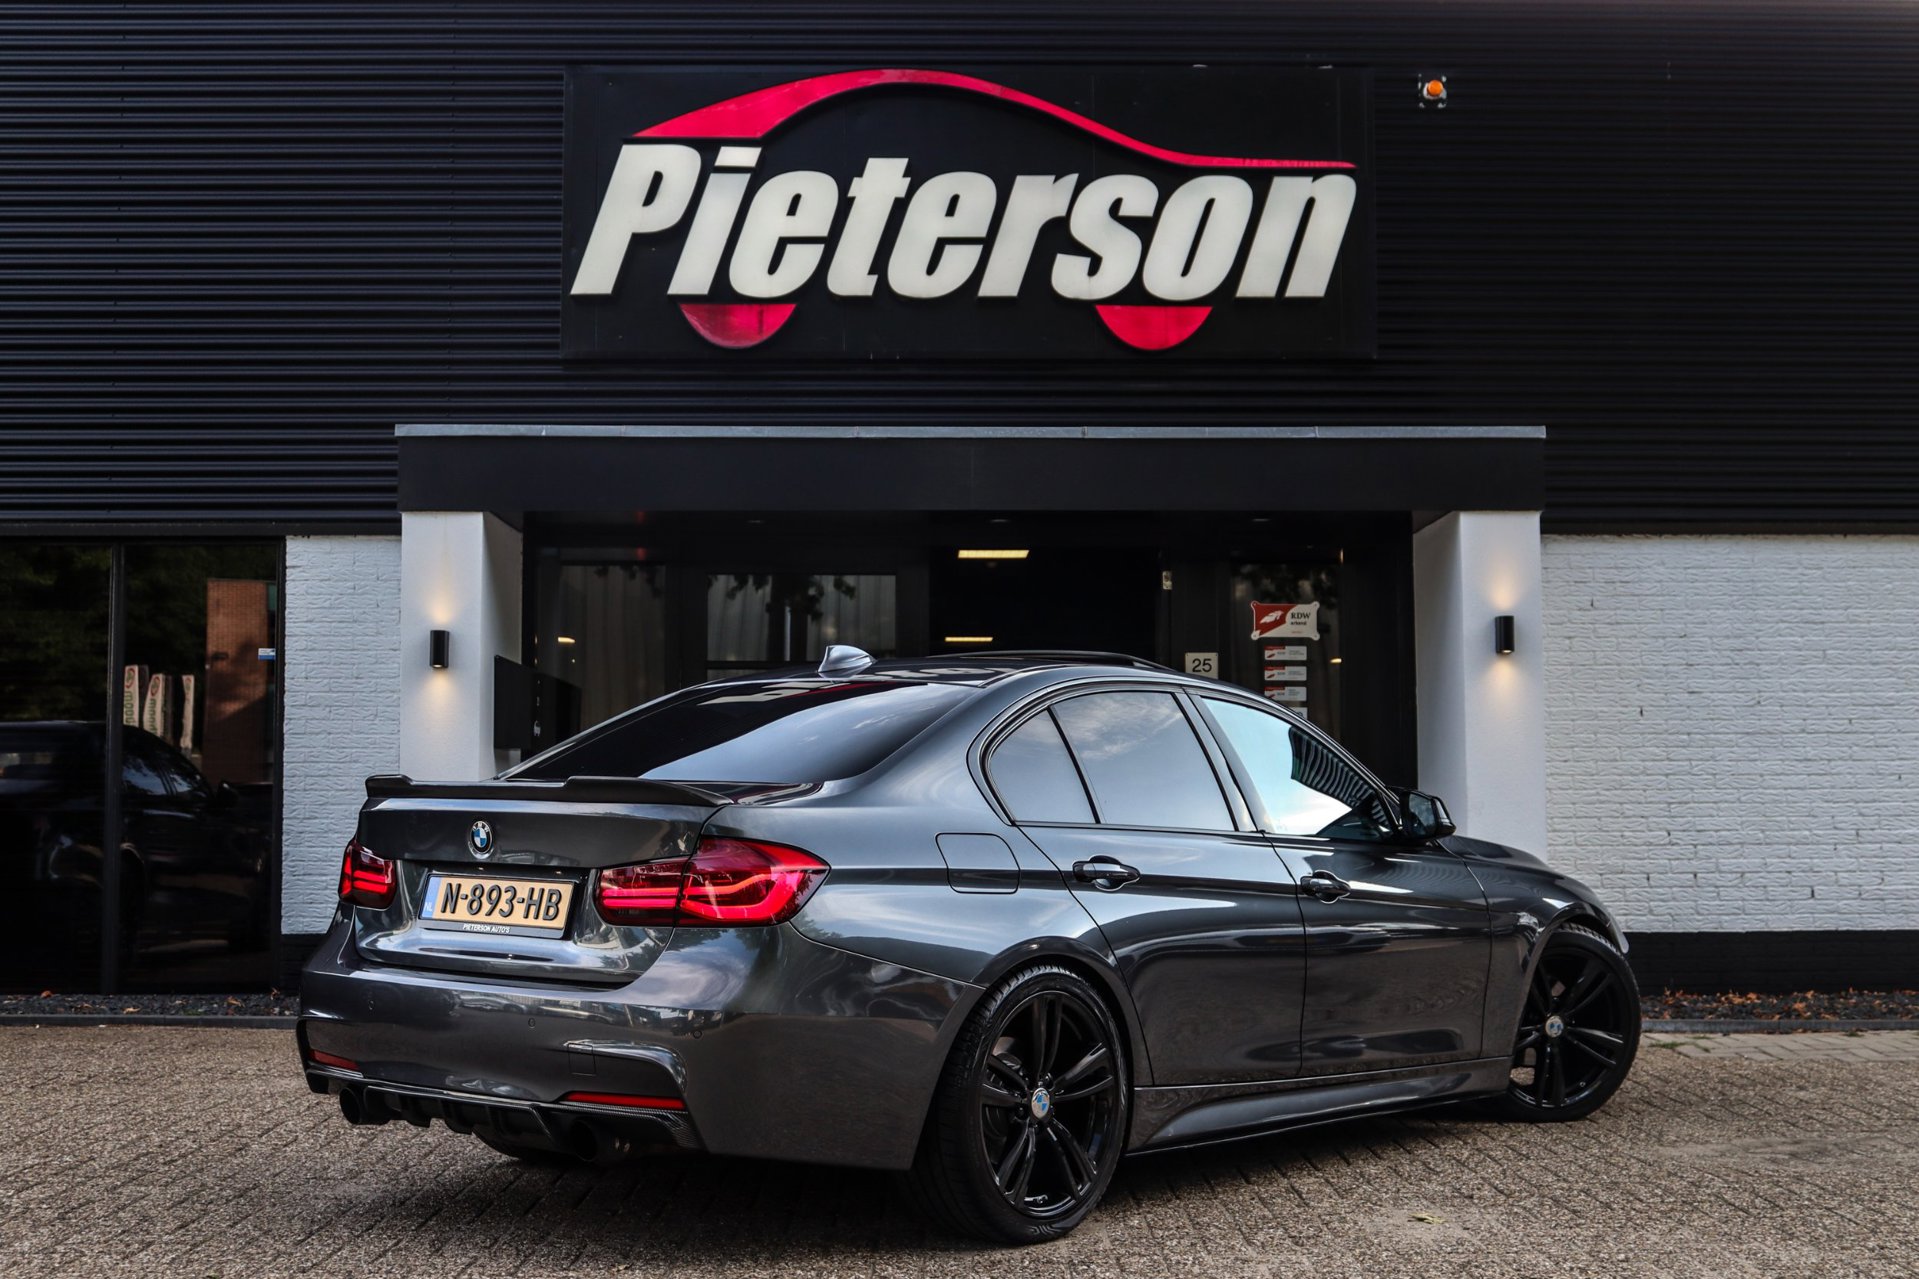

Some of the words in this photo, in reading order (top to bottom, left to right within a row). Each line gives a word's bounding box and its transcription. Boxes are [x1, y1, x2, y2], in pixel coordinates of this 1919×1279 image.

[570, 143, 1358, 302] Pieterson
[1290, 612, 1311, 620] RDW
[1192, 658, 1212, 673] 25
[424, 902, 433, 912] NL
[440, 882, 562, 922] N-893-HB
[462, 923, 491, 933] PIETERSON
